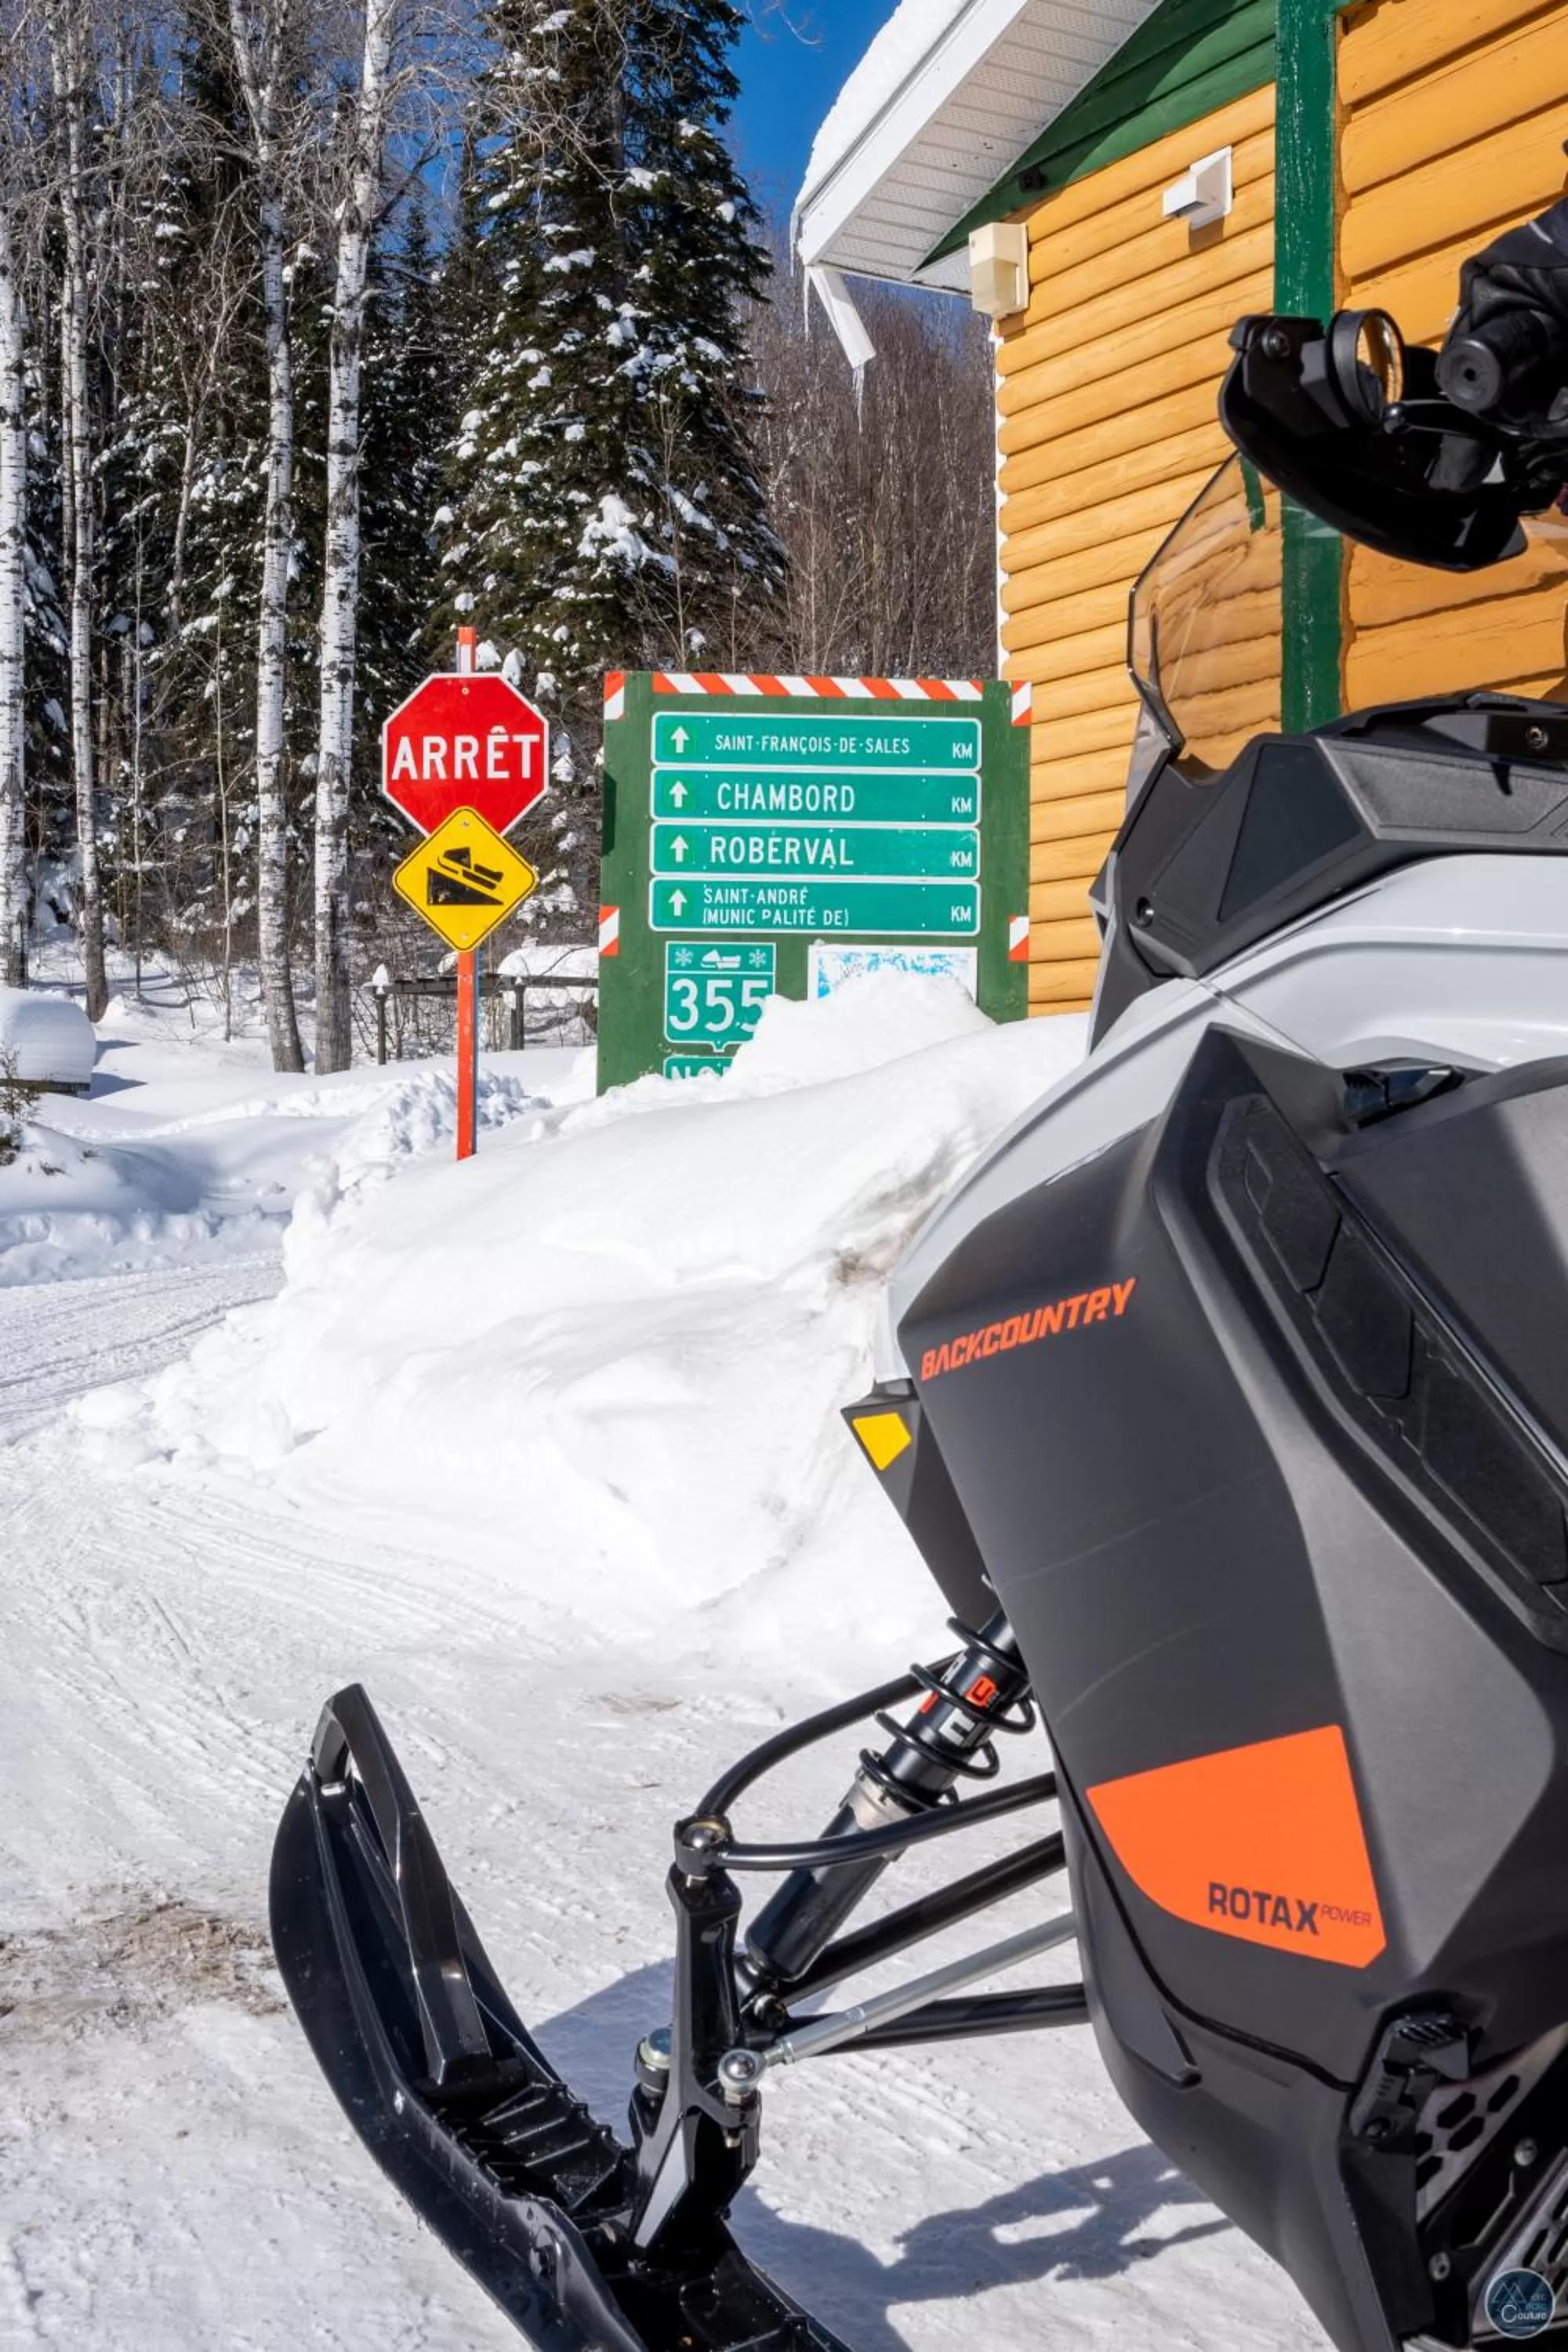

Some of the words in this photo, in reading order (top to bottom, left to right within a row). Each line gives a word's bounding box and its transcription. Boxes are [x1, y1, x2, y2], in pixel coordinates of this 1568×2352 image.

[392, 725, 539, 780] ARRÊT
[953, 742, 973, 759] KM
[717, 782, 855, 812] CHAMBORD
[951, 797, 972, 814] KM
[710, 836, 855, 866] ROBERVAL
[951, 851, 973, 868] KM
[704, 886, 808, 906] SAINT-ANDRÉ
[823, 908, 849, 927] DE)
[950, 906, 971, 923] KM
[669, 978, 769, 1033] 355
[920, 1277, 1136, 1381] BACKCOUNTRY
[1208, 1882, 1319, 1936] ROTAX
[1320, 1904, 1372, 1926] POWER
